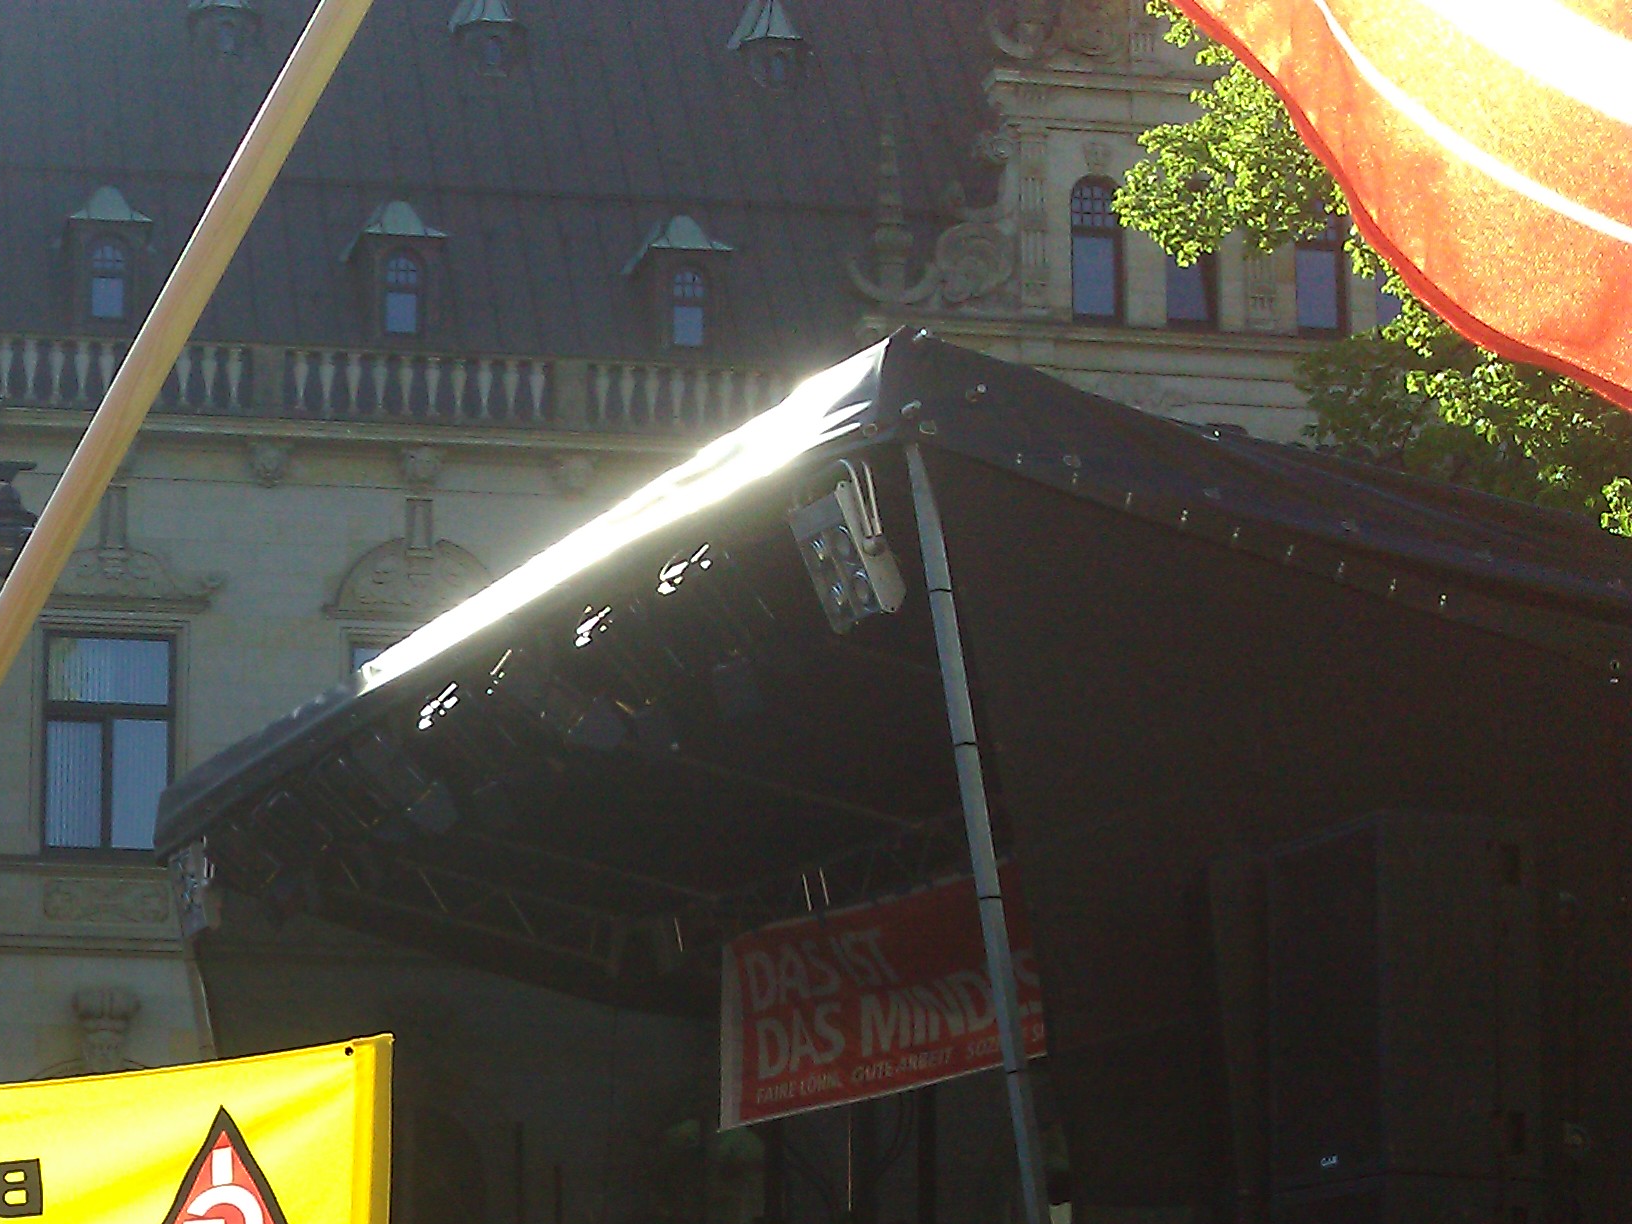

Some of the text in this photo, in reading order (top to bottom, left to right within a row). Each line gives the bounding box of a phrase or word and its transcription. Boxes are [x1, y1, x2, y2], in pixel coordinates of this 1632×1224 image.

[744, 928, 900, 1012] DAS IST
[756, 1002, 846, 1079] DAS
